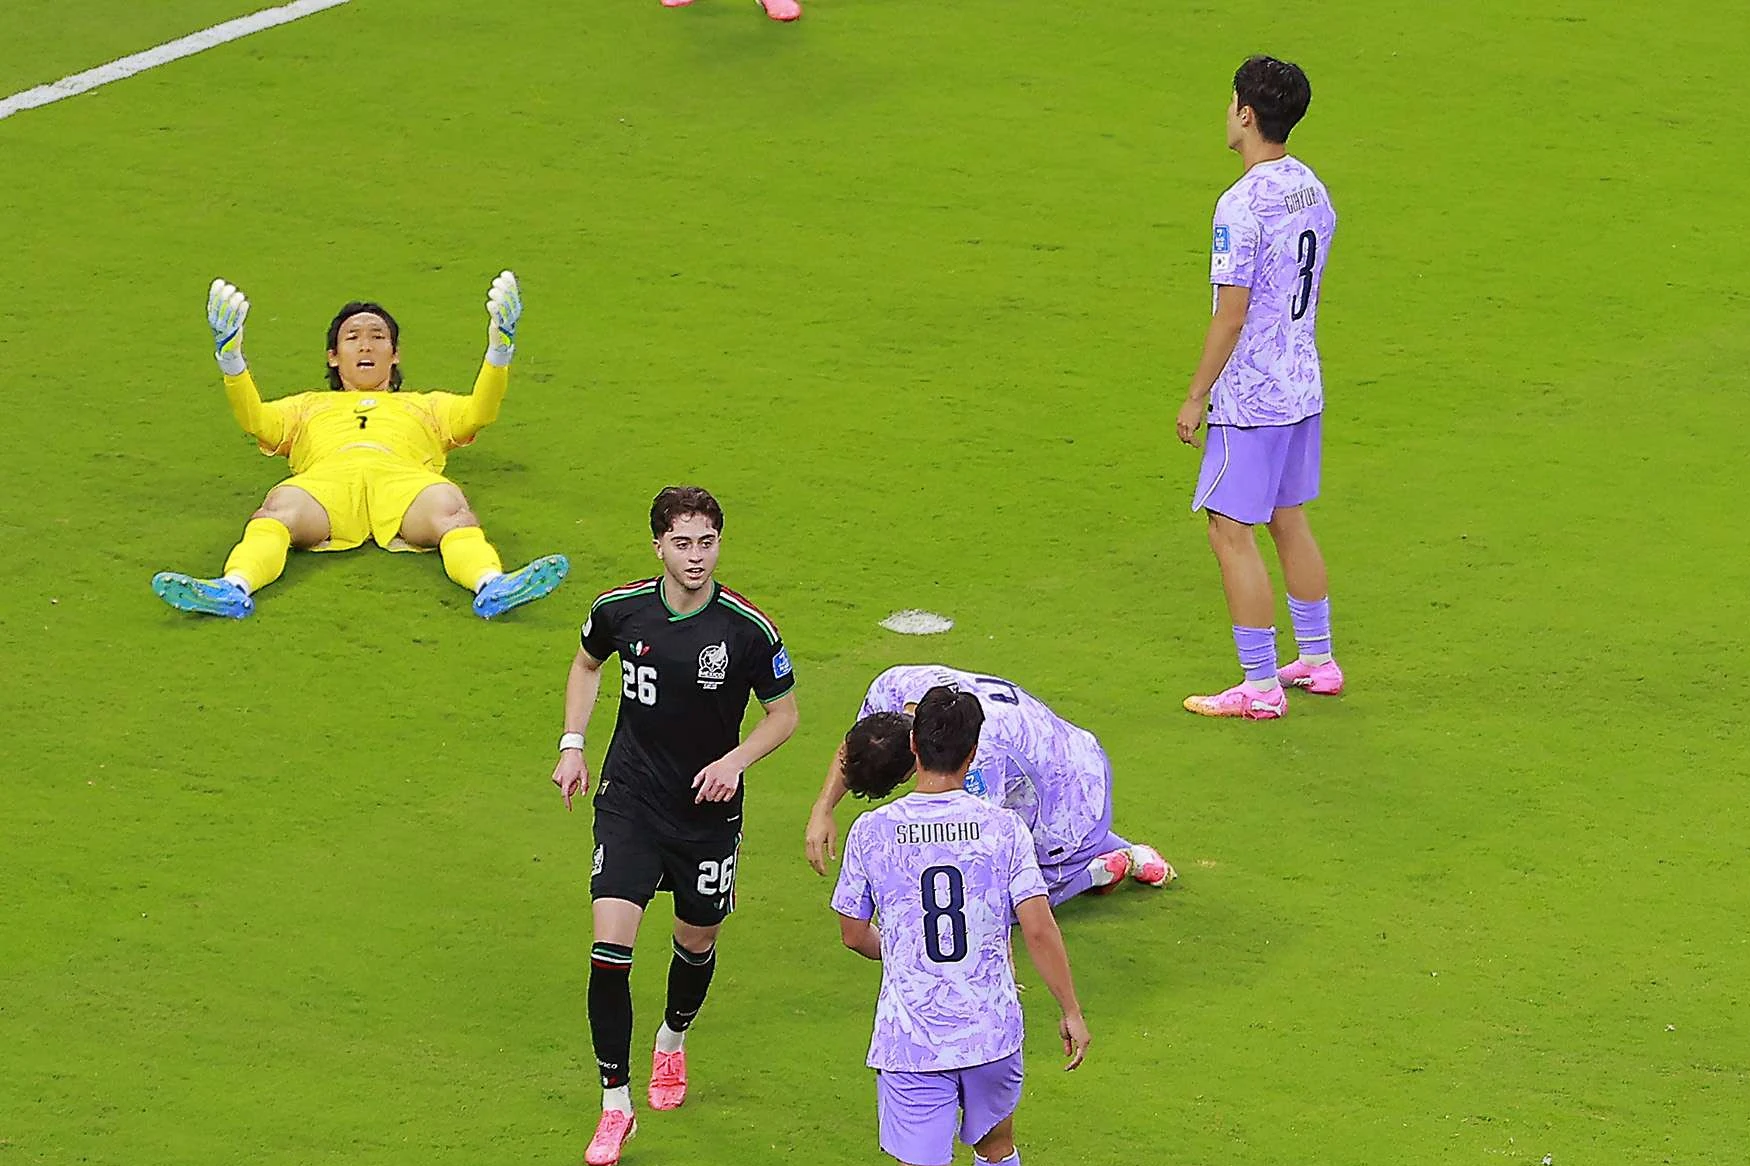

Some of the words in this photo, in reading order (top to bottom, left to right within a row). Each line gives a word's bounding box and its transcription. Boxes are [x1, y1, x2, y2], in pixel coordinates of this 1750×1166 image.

[1291, 229, 1318, 322] 3
[622, 660, 657, 706] 26
[896, 821, 981, 844] SEUNGHO
[697, 855, 734, 896] 26
[920, 864, 968, 963] 8
